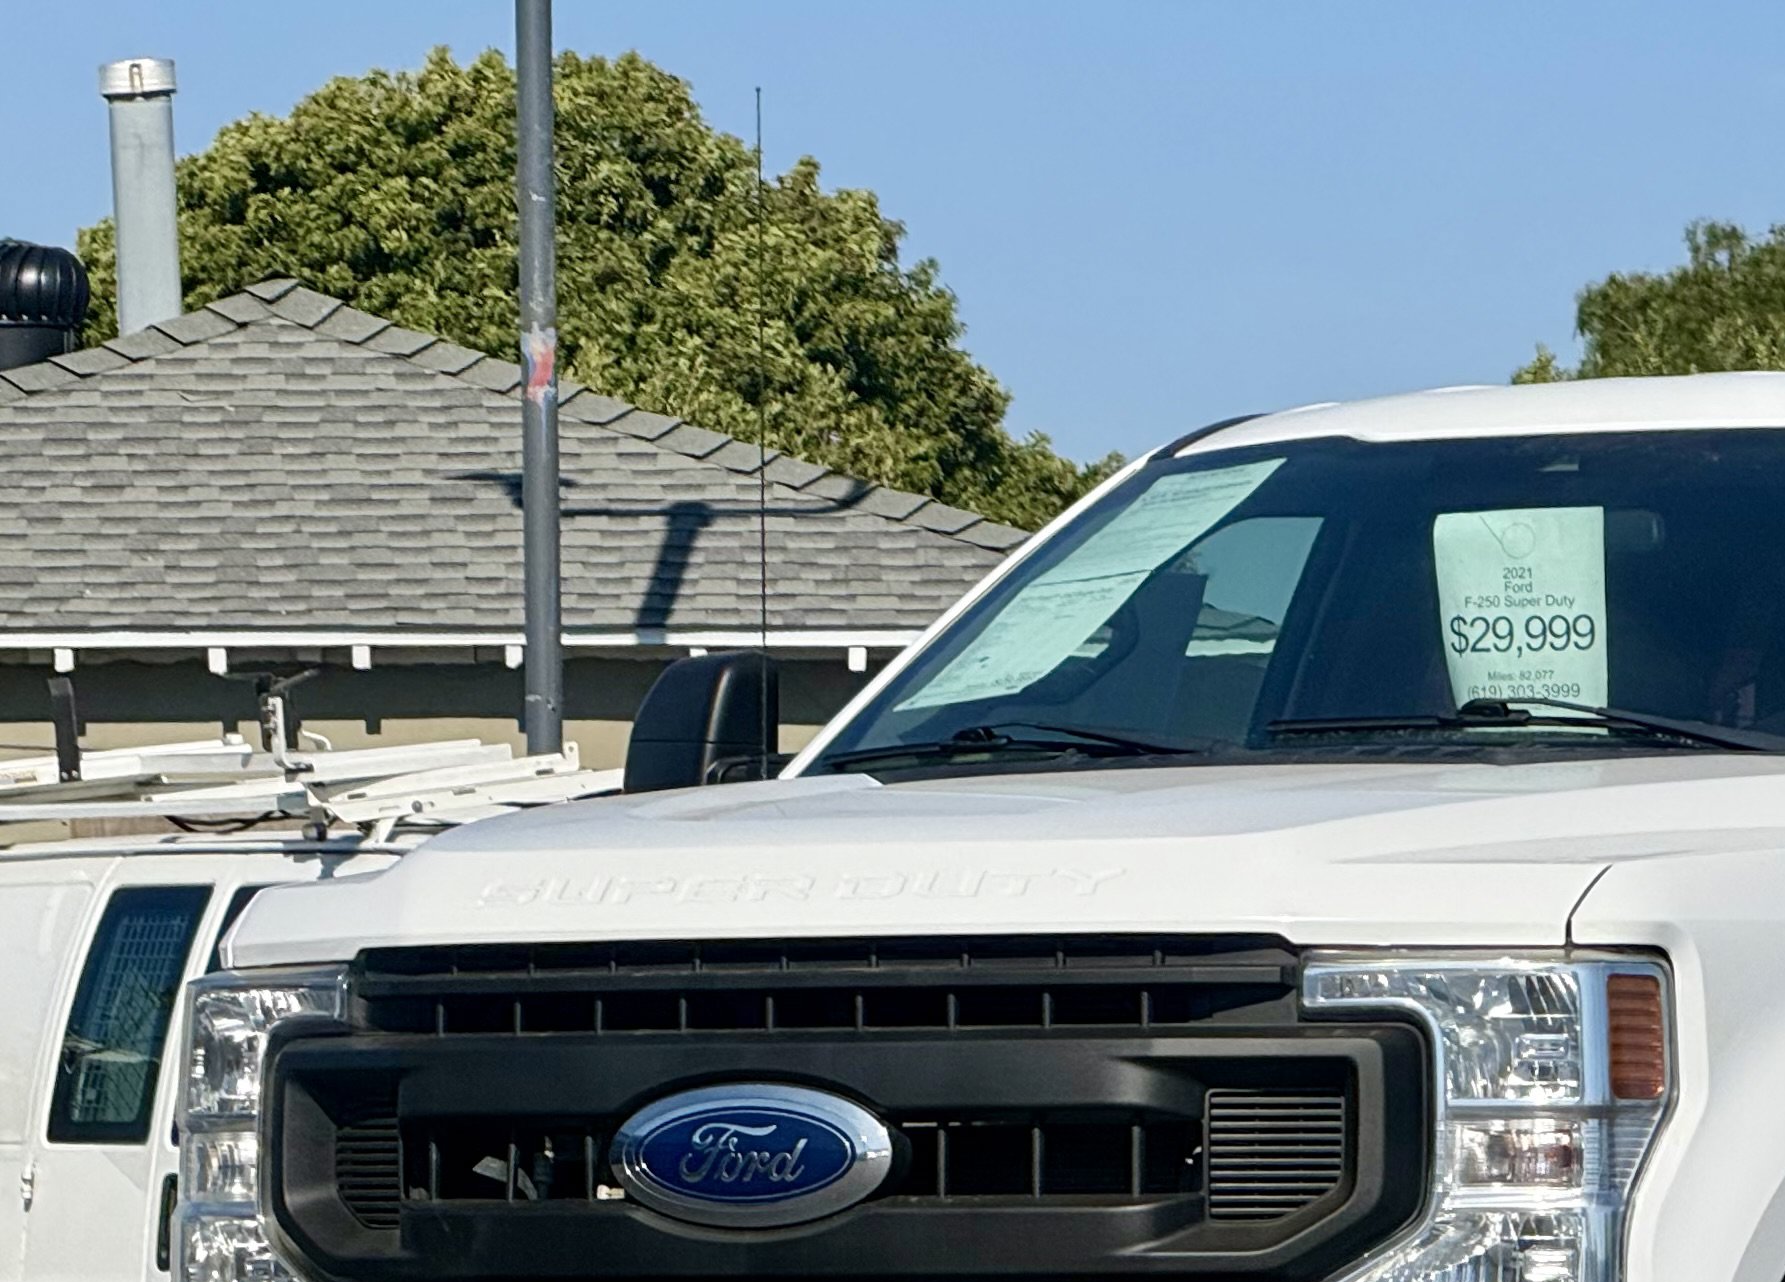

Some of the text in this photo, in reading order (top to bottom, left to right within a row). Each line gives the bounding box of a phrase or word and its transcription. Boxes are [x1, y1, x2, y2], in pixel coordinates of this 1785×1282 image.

[1503, 567, 1533, 579] 2021
[1504, 581, 1533, 594] Ford
[1464, 595, 1575, 609] F-250 Super Duty
[1450, 614, 1595, 657] $29,999
[1467, 683, 1580, 699] (619) 303-3999
[476, 866, 1128, 910] SUPER DUTY
[679, 1122, 809, 1184] Ford
